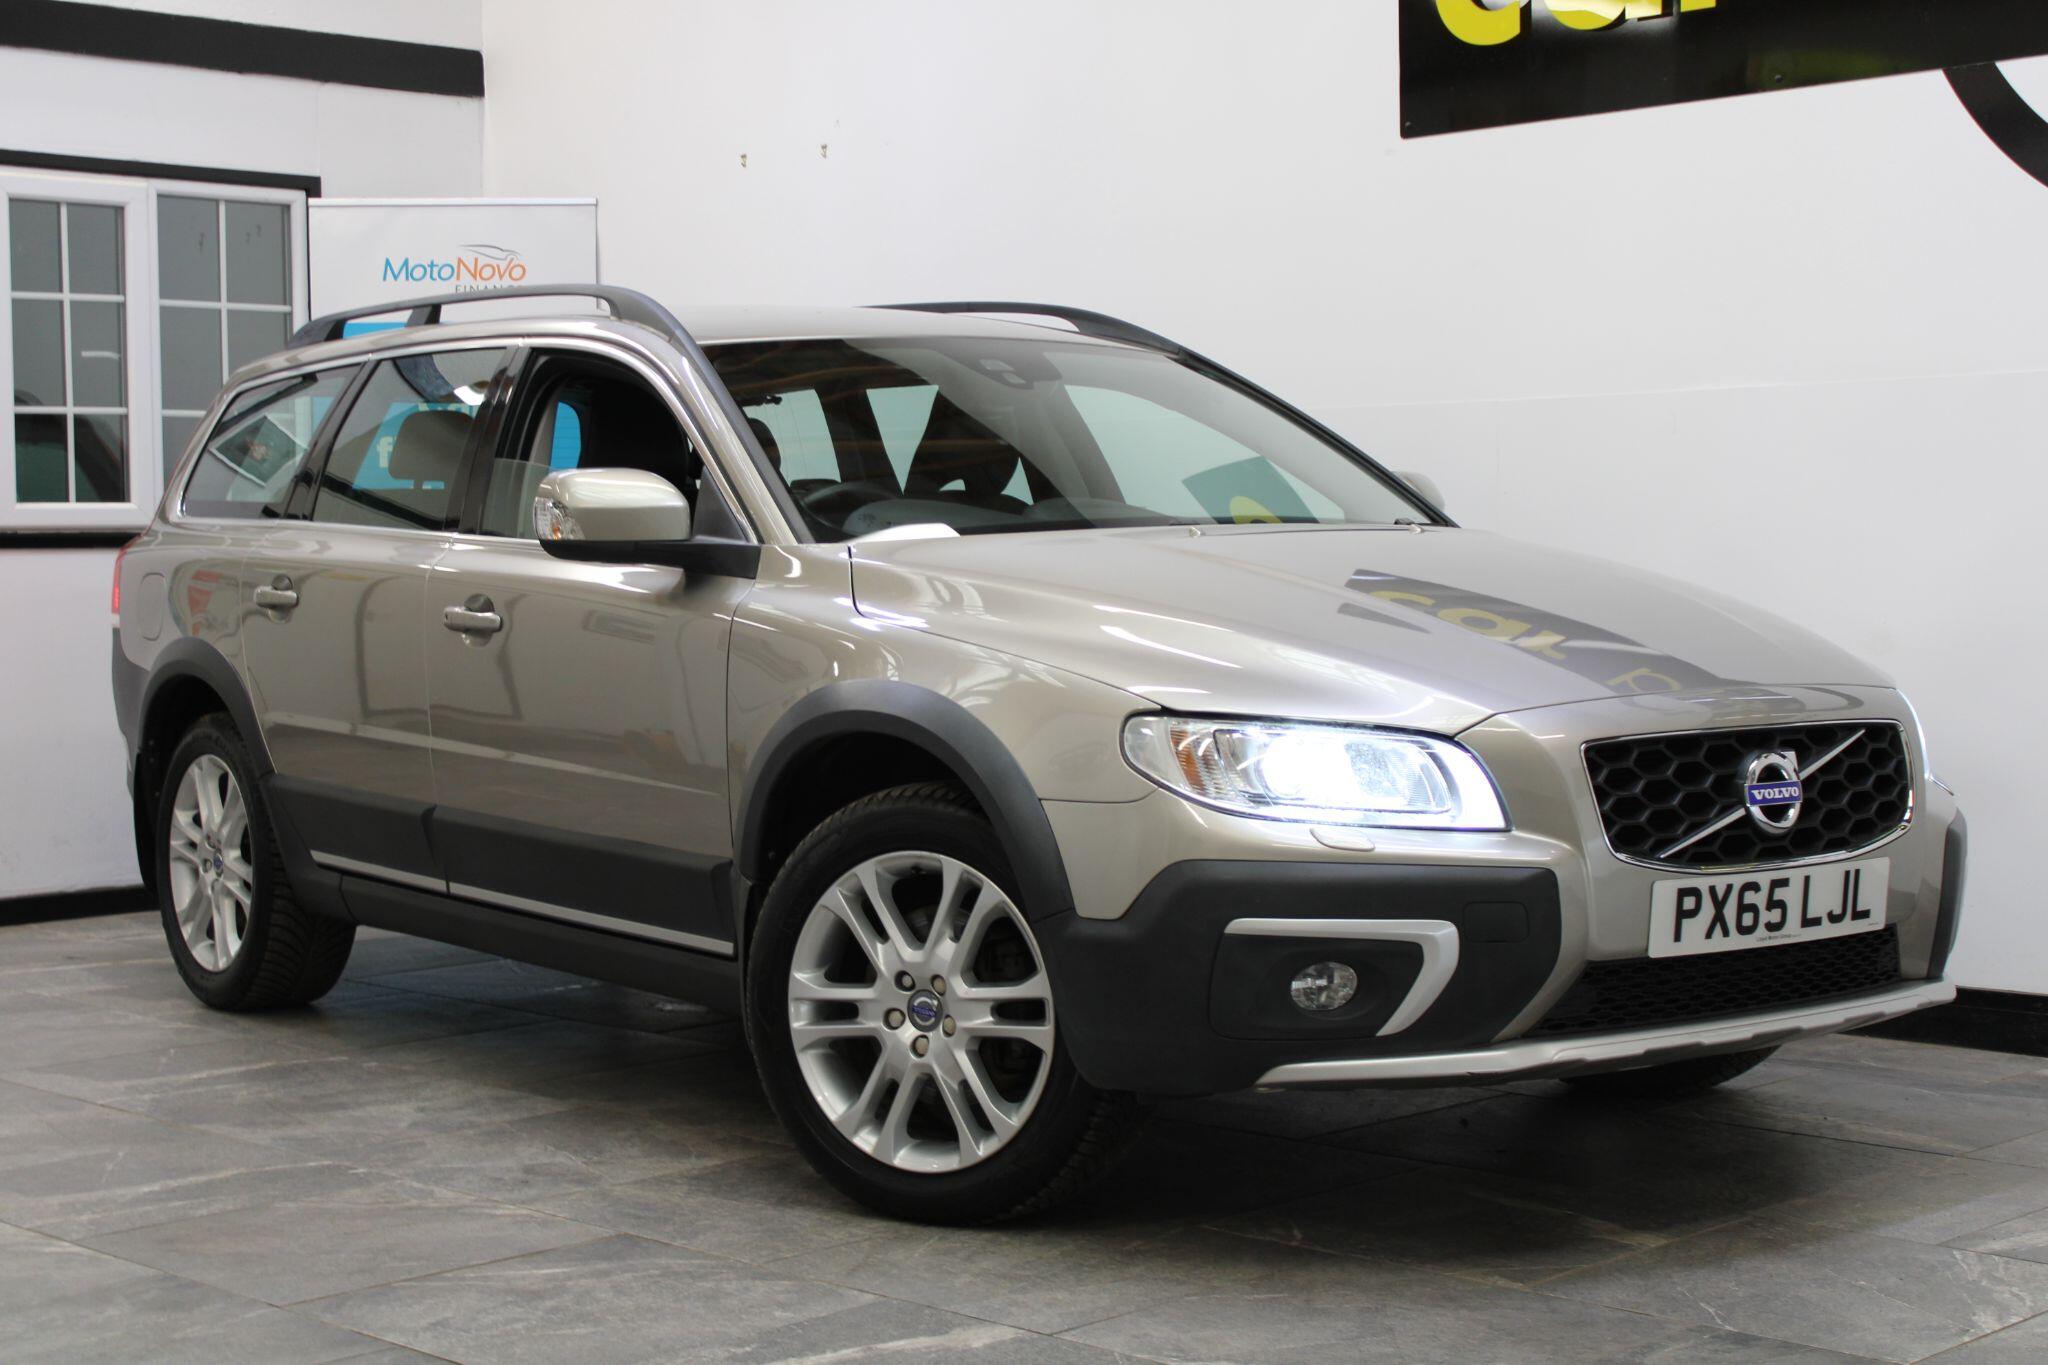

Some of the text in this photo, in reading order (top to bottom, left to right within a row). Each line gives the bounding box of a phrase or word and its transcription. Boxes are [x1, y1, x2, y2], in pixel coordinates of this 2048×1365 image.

[382, 257, 526, 282] MotoNovo
[1751, 787, 1799, 800] VOLVO
[1673, 868, 1871, 942] PX65 LJL
